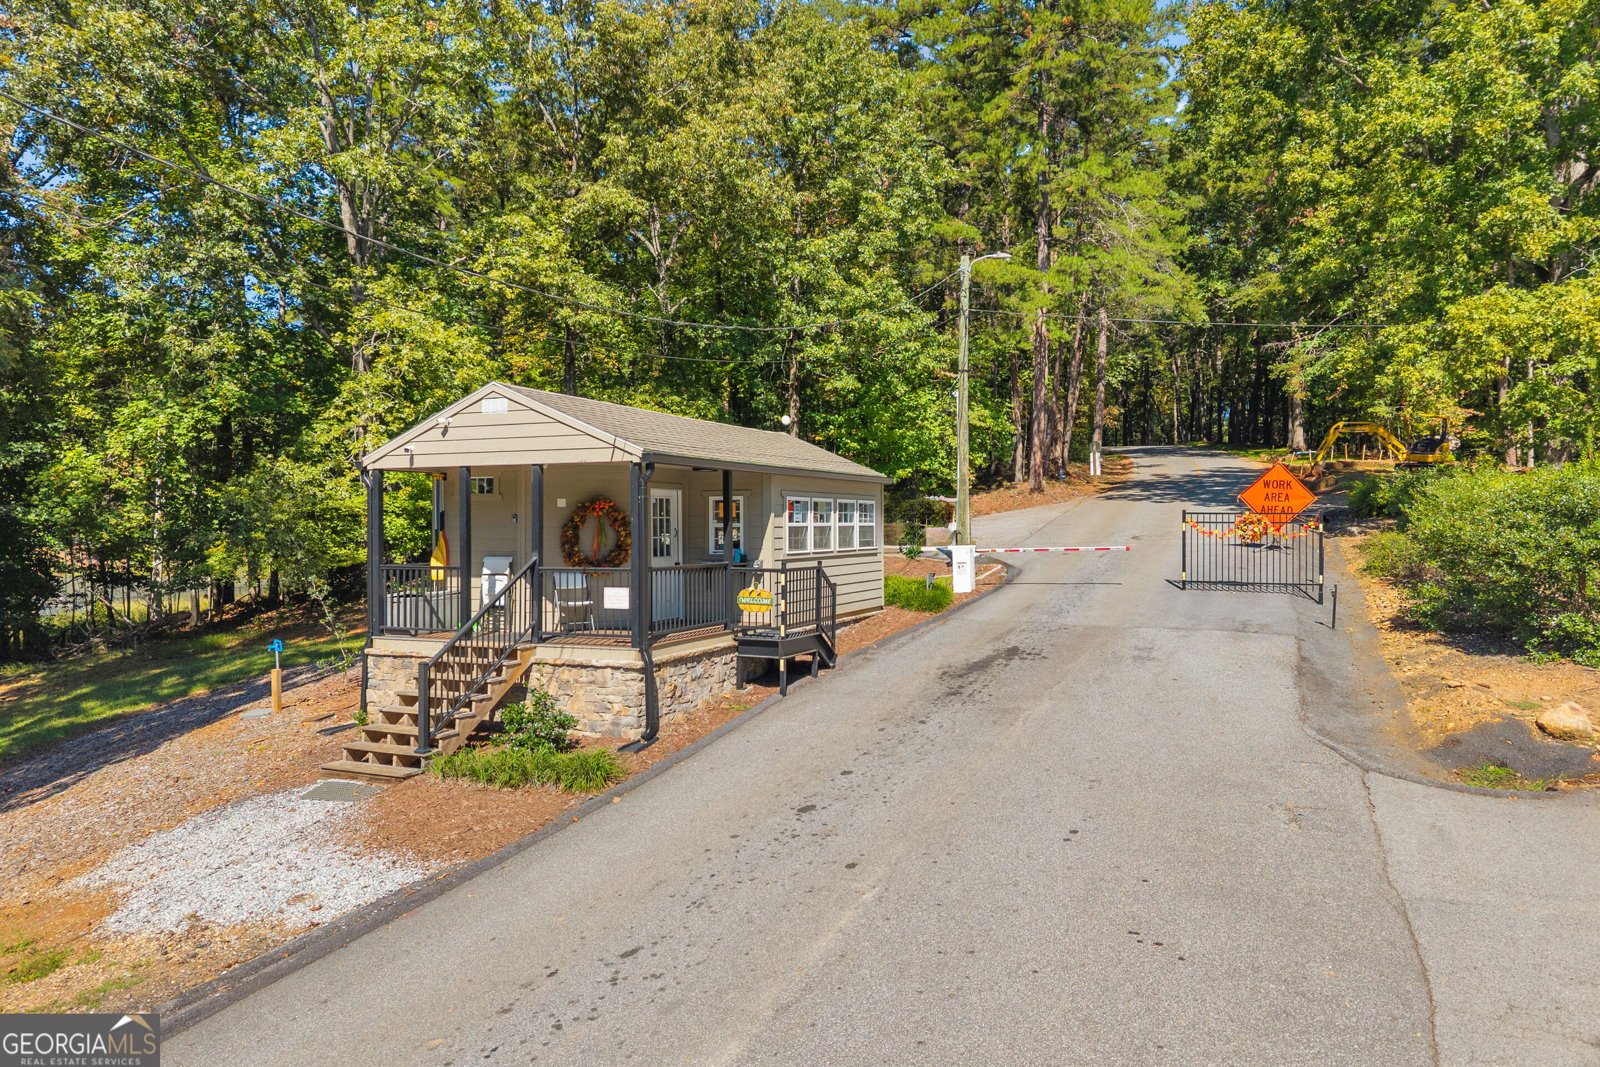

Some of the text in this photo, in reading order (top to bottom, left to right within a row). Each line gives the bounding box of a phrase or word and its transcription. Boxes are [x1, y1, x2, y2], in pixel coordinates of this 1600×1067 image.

[1263, 479, 1292, 490] WORK
[1264, 492, 1290, 503] AREA
[1260, 504, 1294, 514] AHEAD
[740, 597, 772, 605] WELCOME
